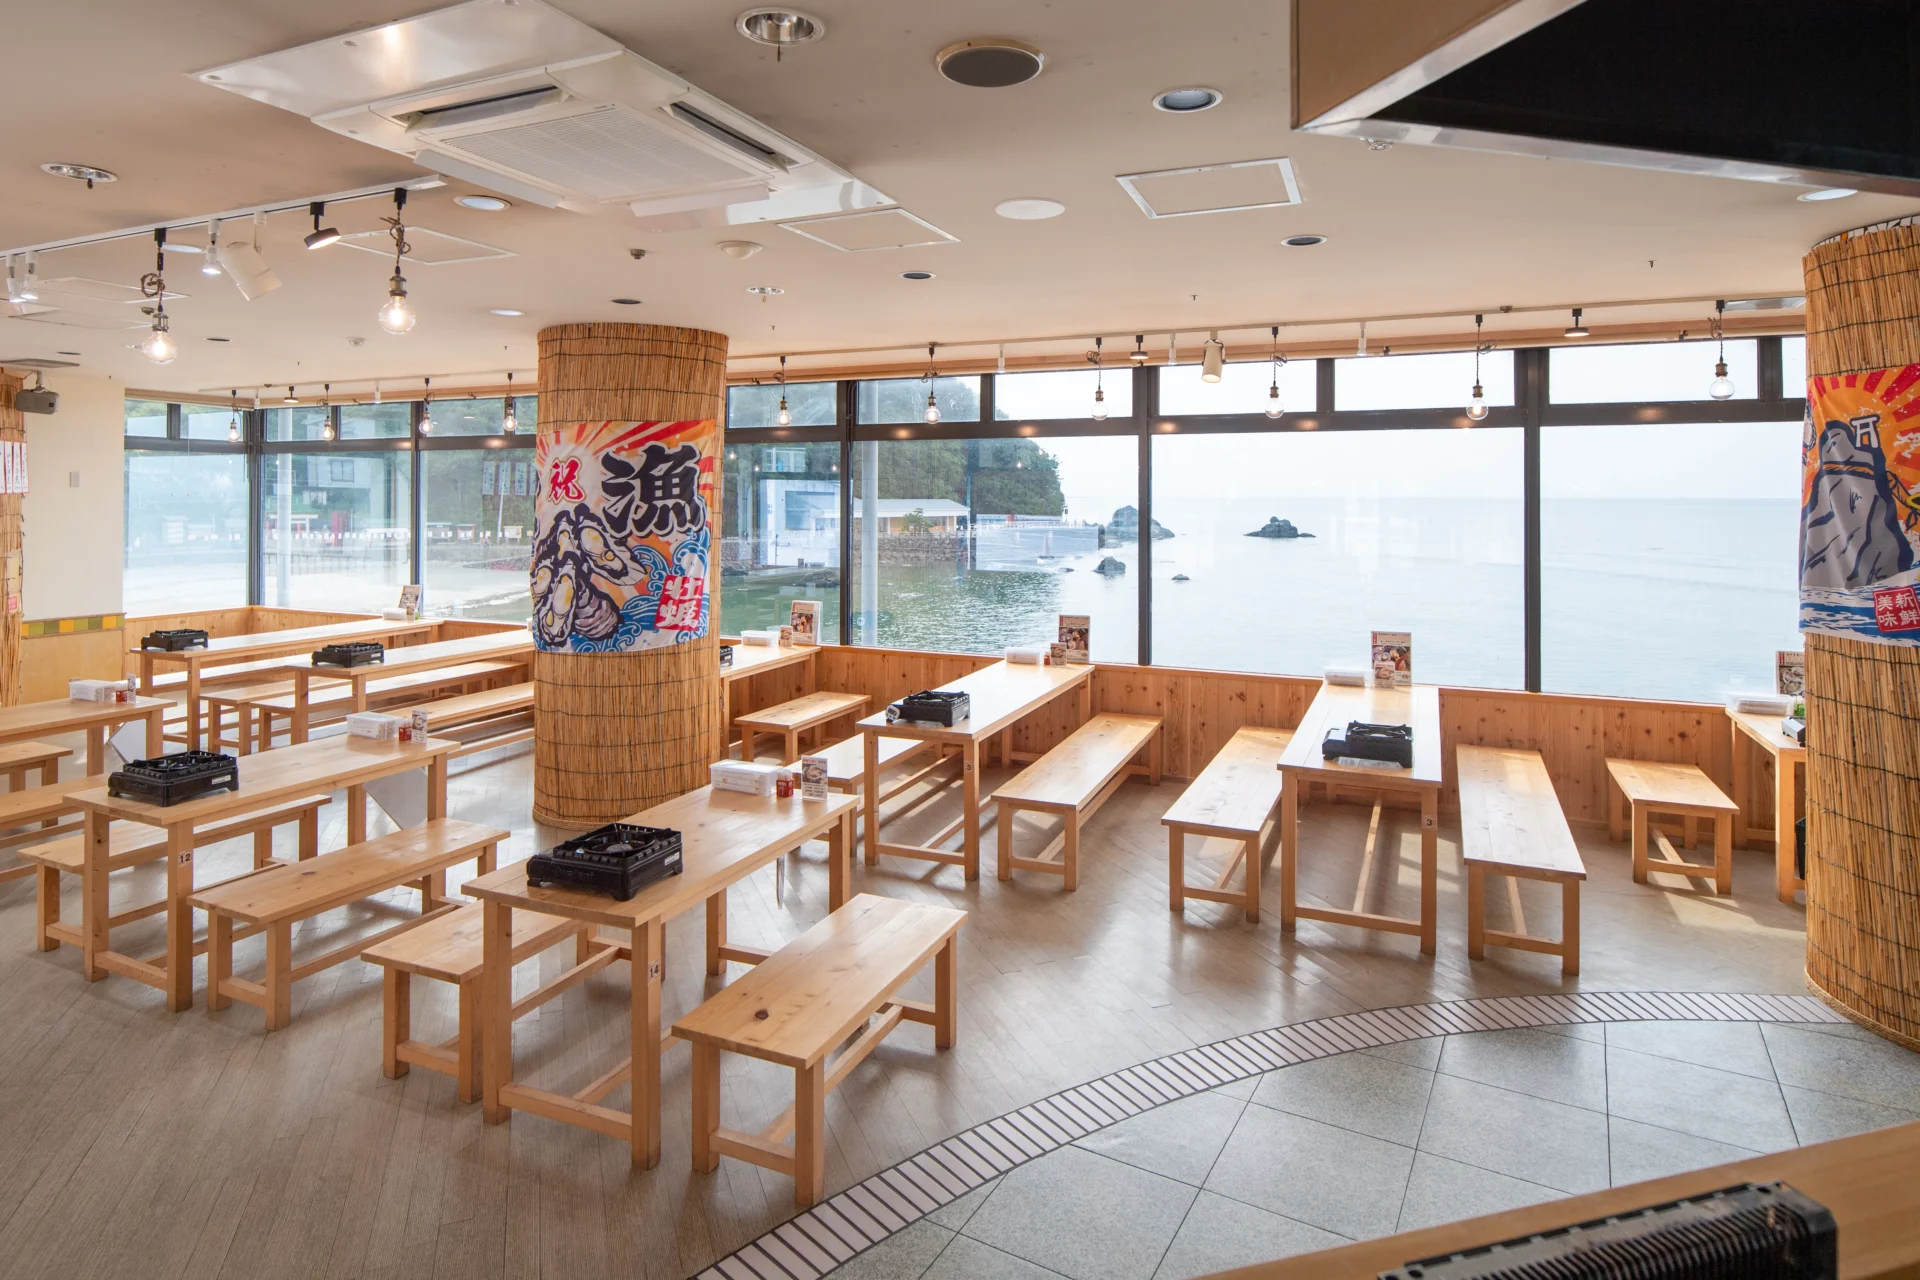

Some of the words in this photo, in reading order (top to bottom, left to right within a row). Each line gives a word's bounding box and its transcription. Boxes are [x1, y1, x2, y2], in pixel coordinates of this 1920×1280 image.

[549, 458, 584, 502] 祝
[600, 444, 706, 534] 漁
[655, 575, 702, 629] 牡蠣
[1877, 594, 1899, 627] 美味
[1895, 592, 1920, 626] 新鮮
[1426, 818, 1433, 827] 3
[179, 853, 191, 864] 12
[649, 963, 660, 978] 14
